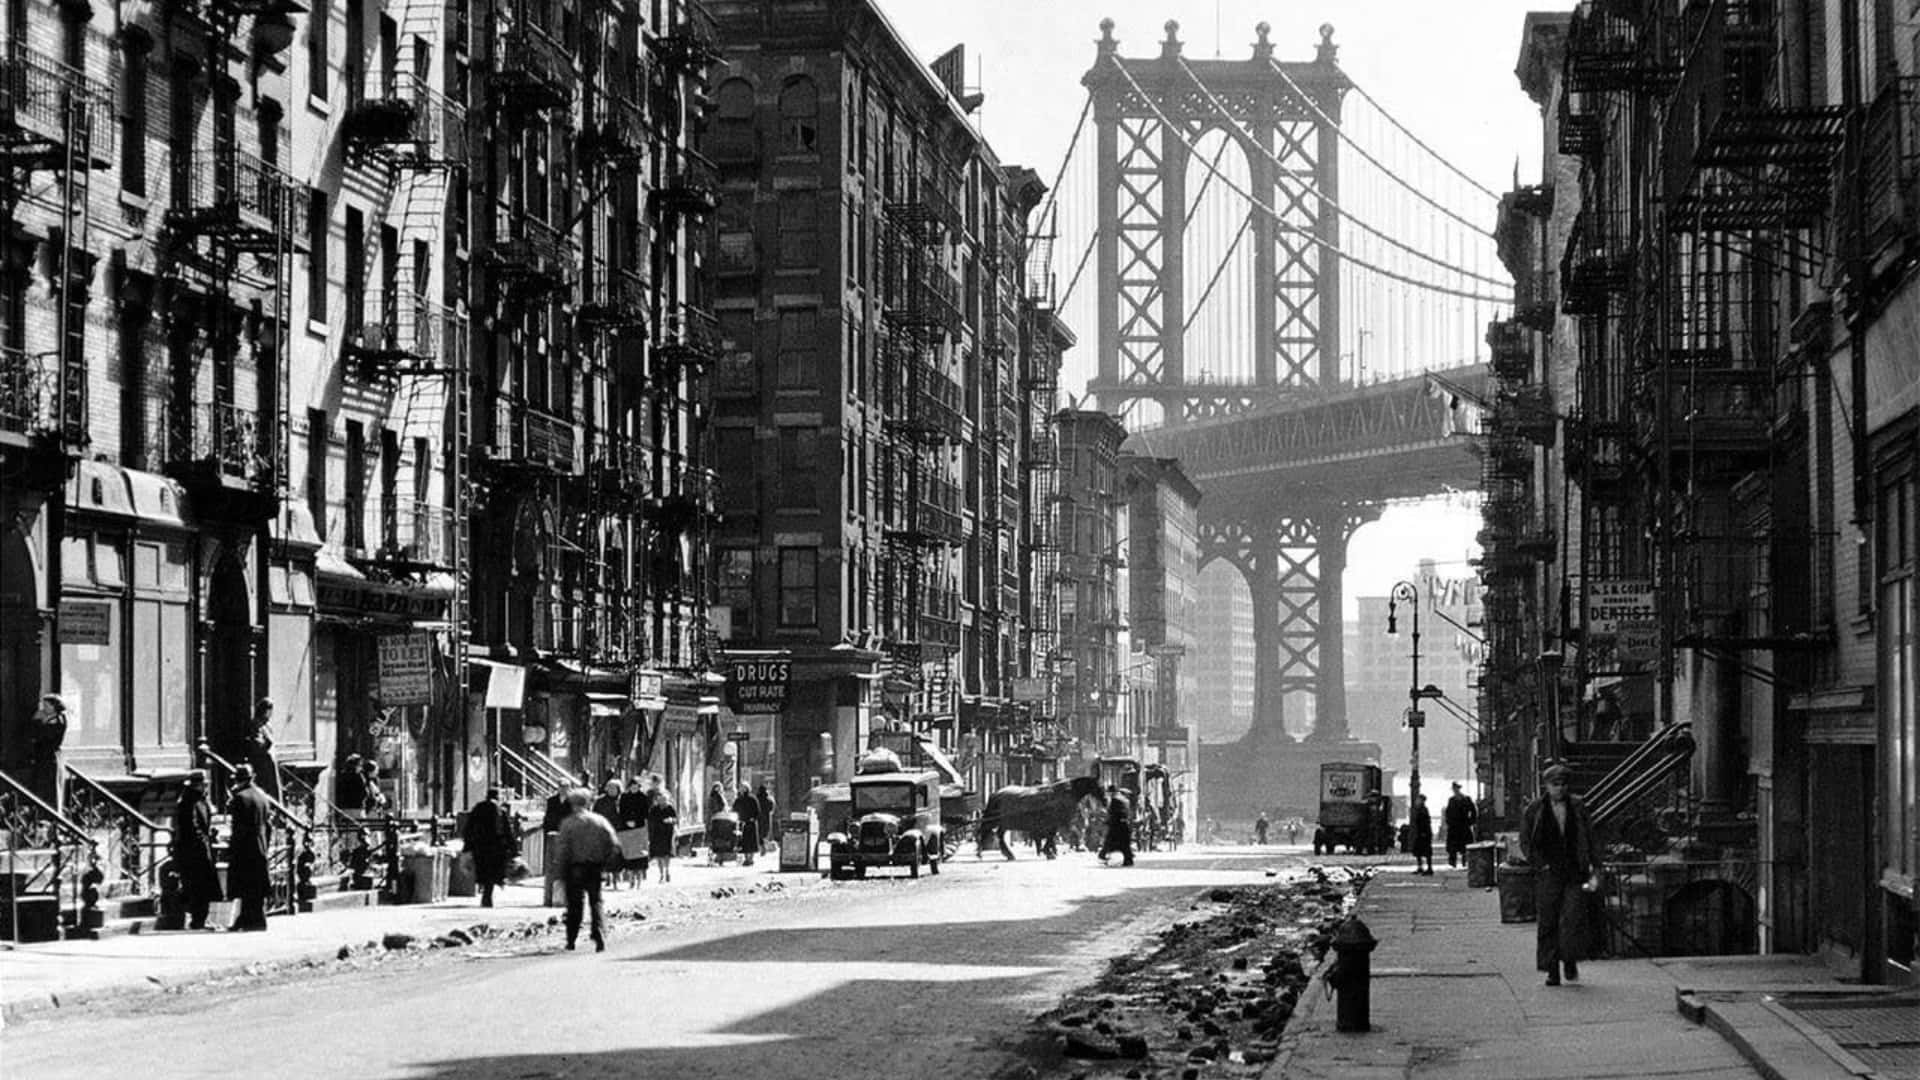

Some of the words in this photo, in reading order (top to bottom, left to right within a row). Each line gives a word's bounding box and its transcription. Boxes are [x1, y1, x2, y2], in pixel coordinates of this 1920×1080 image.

[1591, 606, 1651, 620] DENTIST
[382, 648, 398, 661] TO
[401, 647, 425, 660] LET
[737, 664, 788, 681] DRUGS
[739, 686, 757, 698] CUT
[759, 686, 785, 698] RATE
